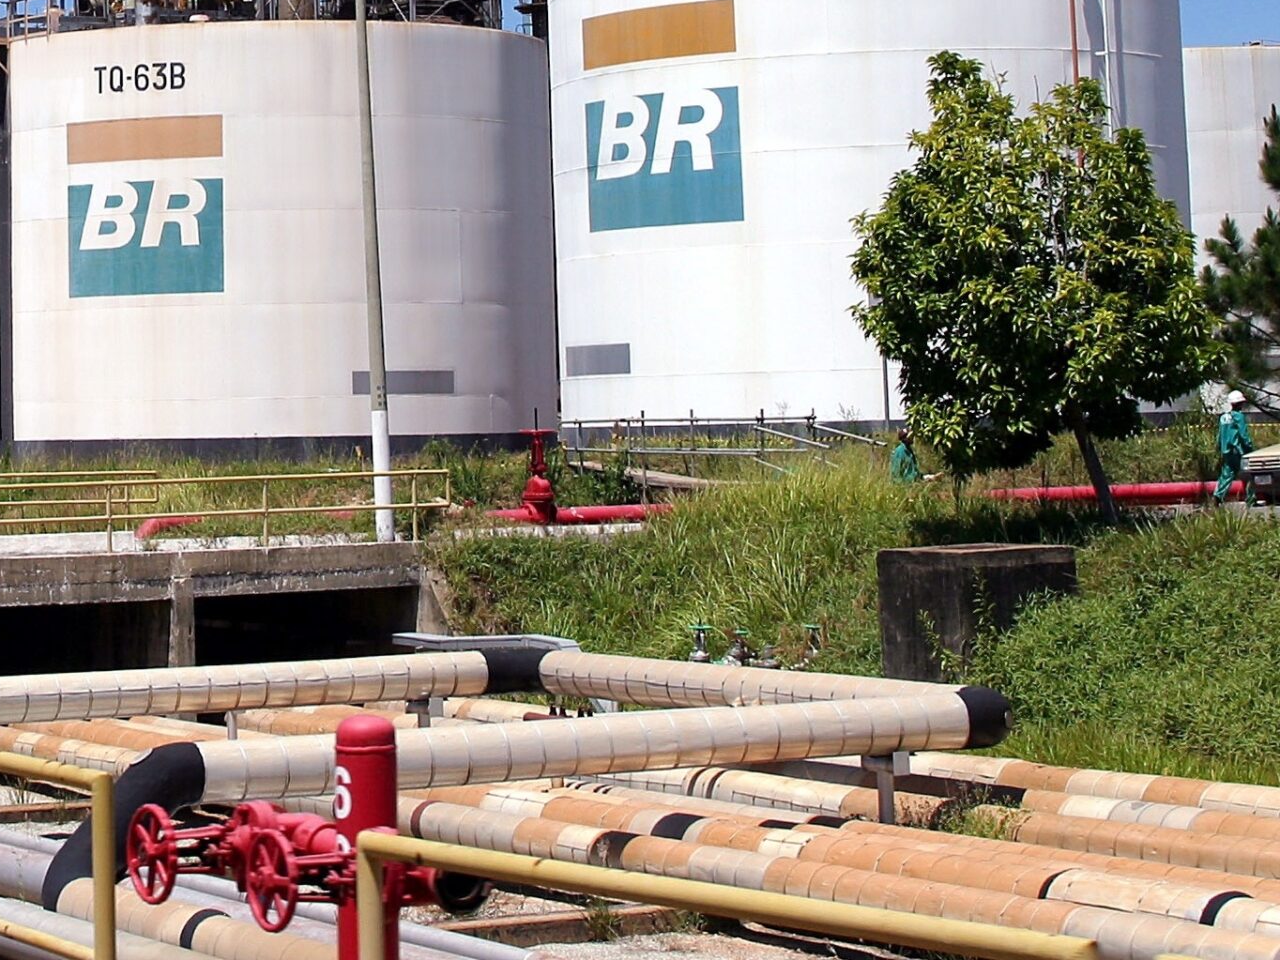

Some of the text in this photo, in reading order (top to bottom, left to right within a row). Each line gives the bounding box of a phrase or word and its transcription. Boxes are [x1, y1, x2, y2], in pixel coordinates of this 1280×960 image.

[93, 62, 187, 94] TQ-63B
[596, 88, 723, 181] BR
[79, 178, 207, 251] BR
